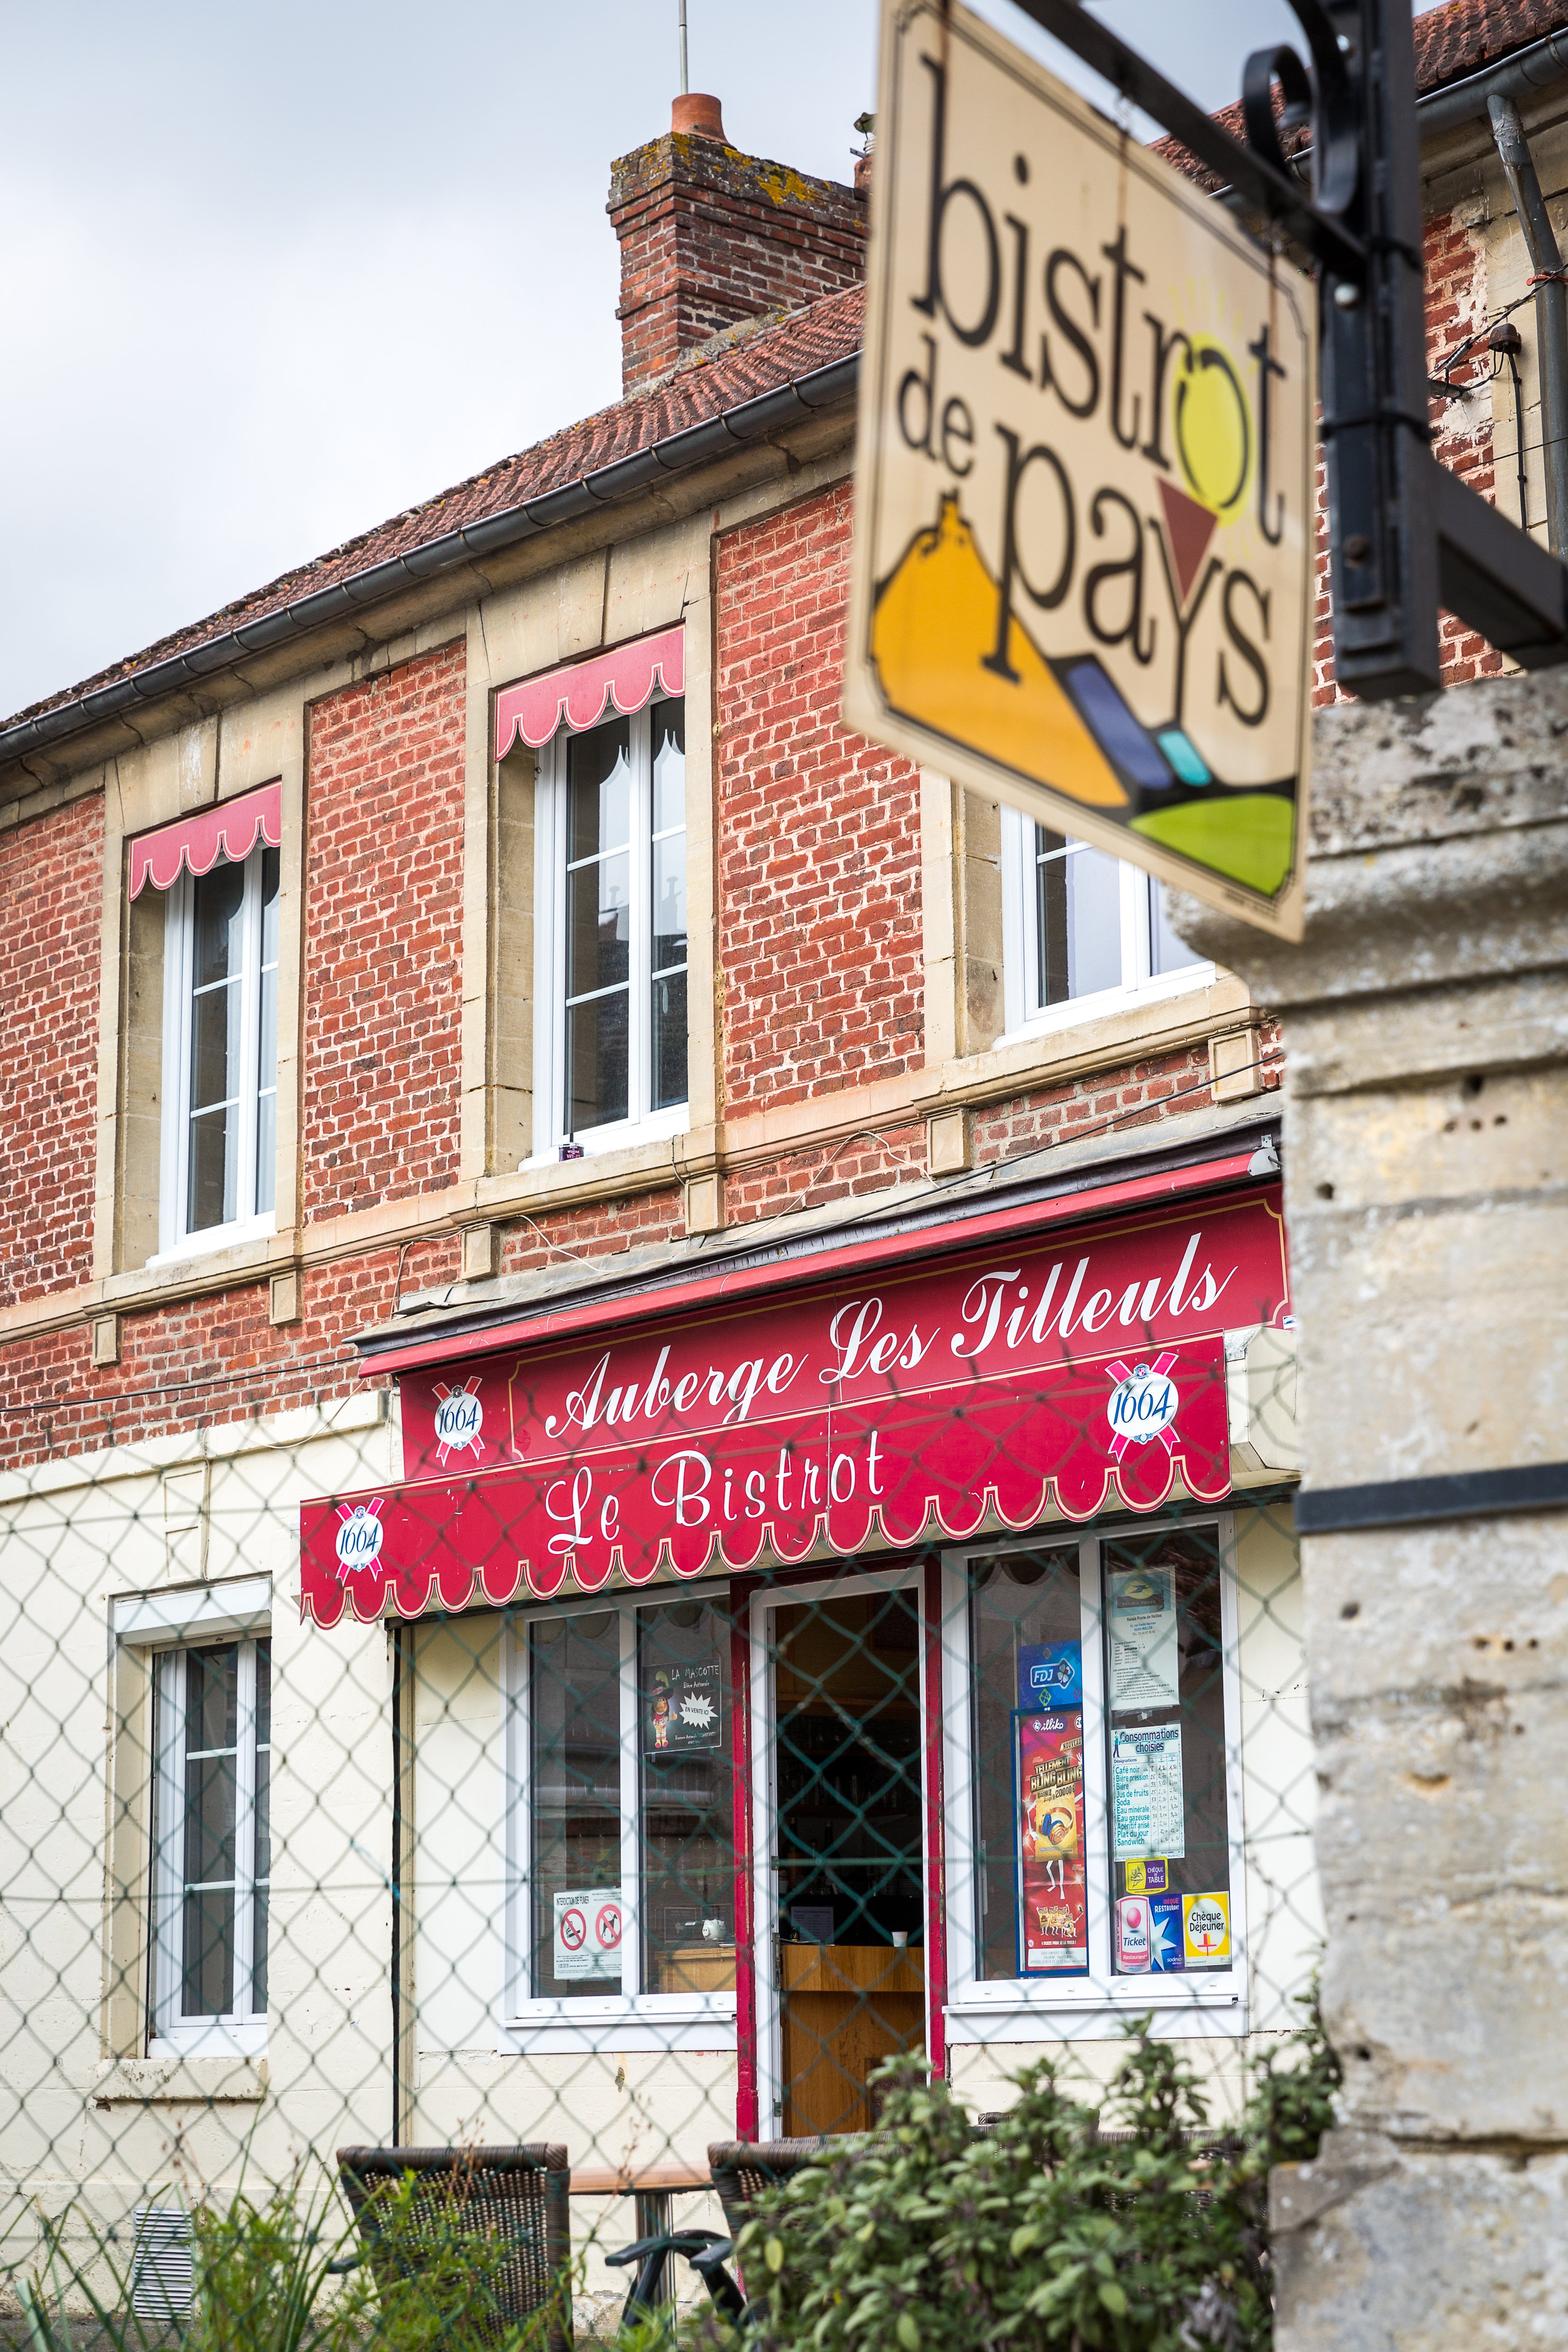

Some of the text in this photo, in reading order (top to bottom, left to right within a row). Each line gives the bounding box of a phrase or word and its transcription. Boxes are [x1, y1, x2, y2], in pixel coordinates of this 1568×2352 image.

[910, 53, 1287, 547] bistrot
[896, 333, 1272, 727] de pays
[545, 1232, 1238, 1438] Auberge Les Tilleuls
[1113, 1381, 1174, 1425] 1664
[439, 1399, 480, 1435] 1664
[545, 1430, 884, 1555] Le Bistrot
[339, 1520, 380, 1556] 1664
[671, 1665, 719, 1681] LA MASCOTTE
[1034, 1669, 1054, 1683] FDJ
[1041, 1718, 1064, 1731] illiko
[1120, 1728, 1179, 1743] Consommations
[1063, 1740, 1082, 1749] NOUVEAU
[1136, 1740, 1164, 1753] choisies
[1035, 1757, 1071, 1774] TELLEMENT
[1031, 1766, 1082, 1792] BLING BLING
[1129, 1773, 1148, 1782] pression
[1134, 1789, 1149, 1797] fruits
[1117, 1798, 1130, 1806] Soda
[1128, 1805, 1149, 1813] minérale
[1117, 1822, 1136, 1831] Apéritif
[1137, 1830, 1149, 1838] jour
[1117, 1837, 1145, 1846] Sandwich
[1155, 1905, 1179, 1913] RESTAURANT
[1192, 1911, 1221, 1922] Chèque
[1190, 1921, 1225, 1933] Déjeuner
[1123, 1937, 1146, 1946] Ticket
